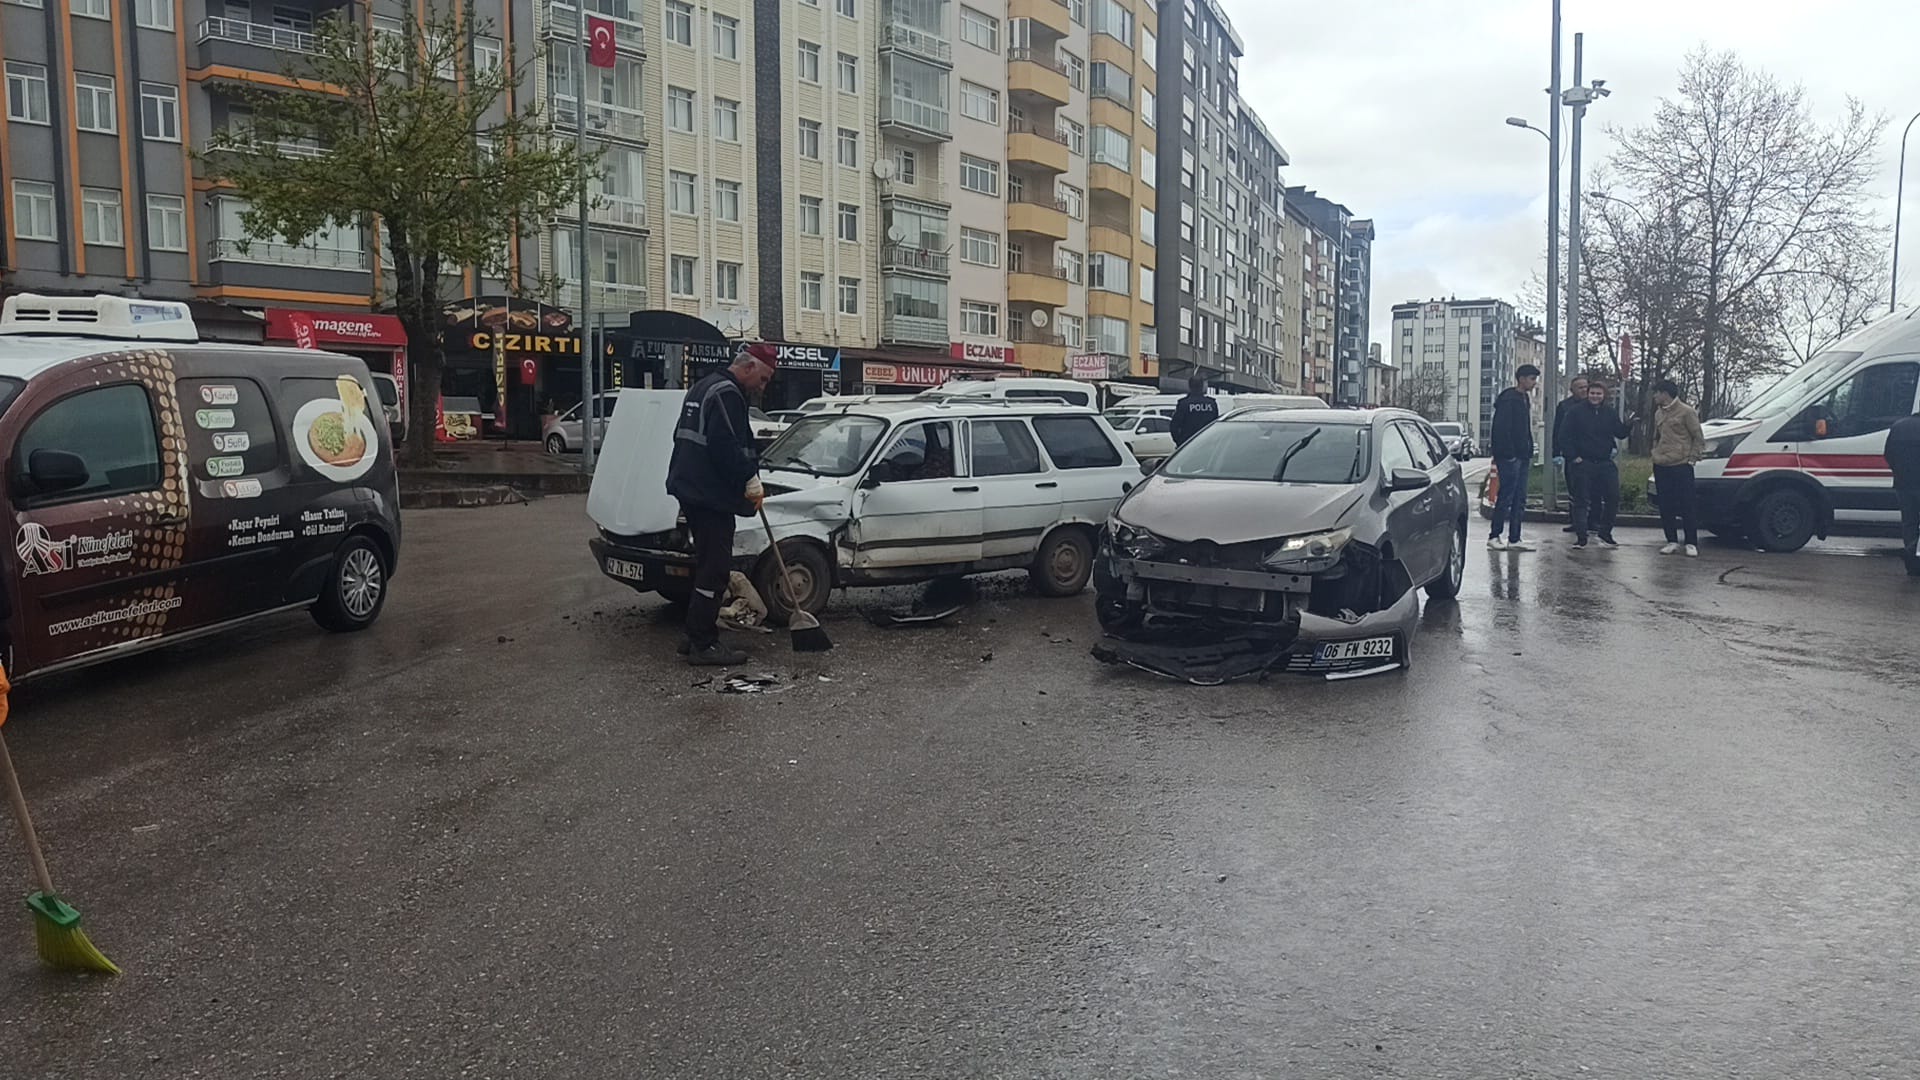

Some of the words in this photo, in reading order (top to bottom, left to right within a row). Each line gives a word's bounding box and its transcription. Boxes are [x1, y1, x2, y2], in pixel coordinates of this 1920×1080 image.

[312, 319, 373, 335] magene
[473, 332, 581, 354] CZIRTI
[966, 344, 1004, 359] ECZANE
[1073, 356, 1106, 368] ECZANE
[865, 366, 894, 377] CEBEL
[231, 519, 253, 533] Kaşar
[254, 514, 280, 530] Peyniri
[305, 525, 317, 536] Gül
[319, 520, 345, 534] Katmeri
[77, 530, 134, 555] Künefeleri
[231, 535, 256, 547] Kesme
[257, 529, 295, 543] Dondurma
[1323, 645, 1340, 658] 06
[1344, 642, 1360, 657] FN
[1362, 639, 1391, 655] 9232
